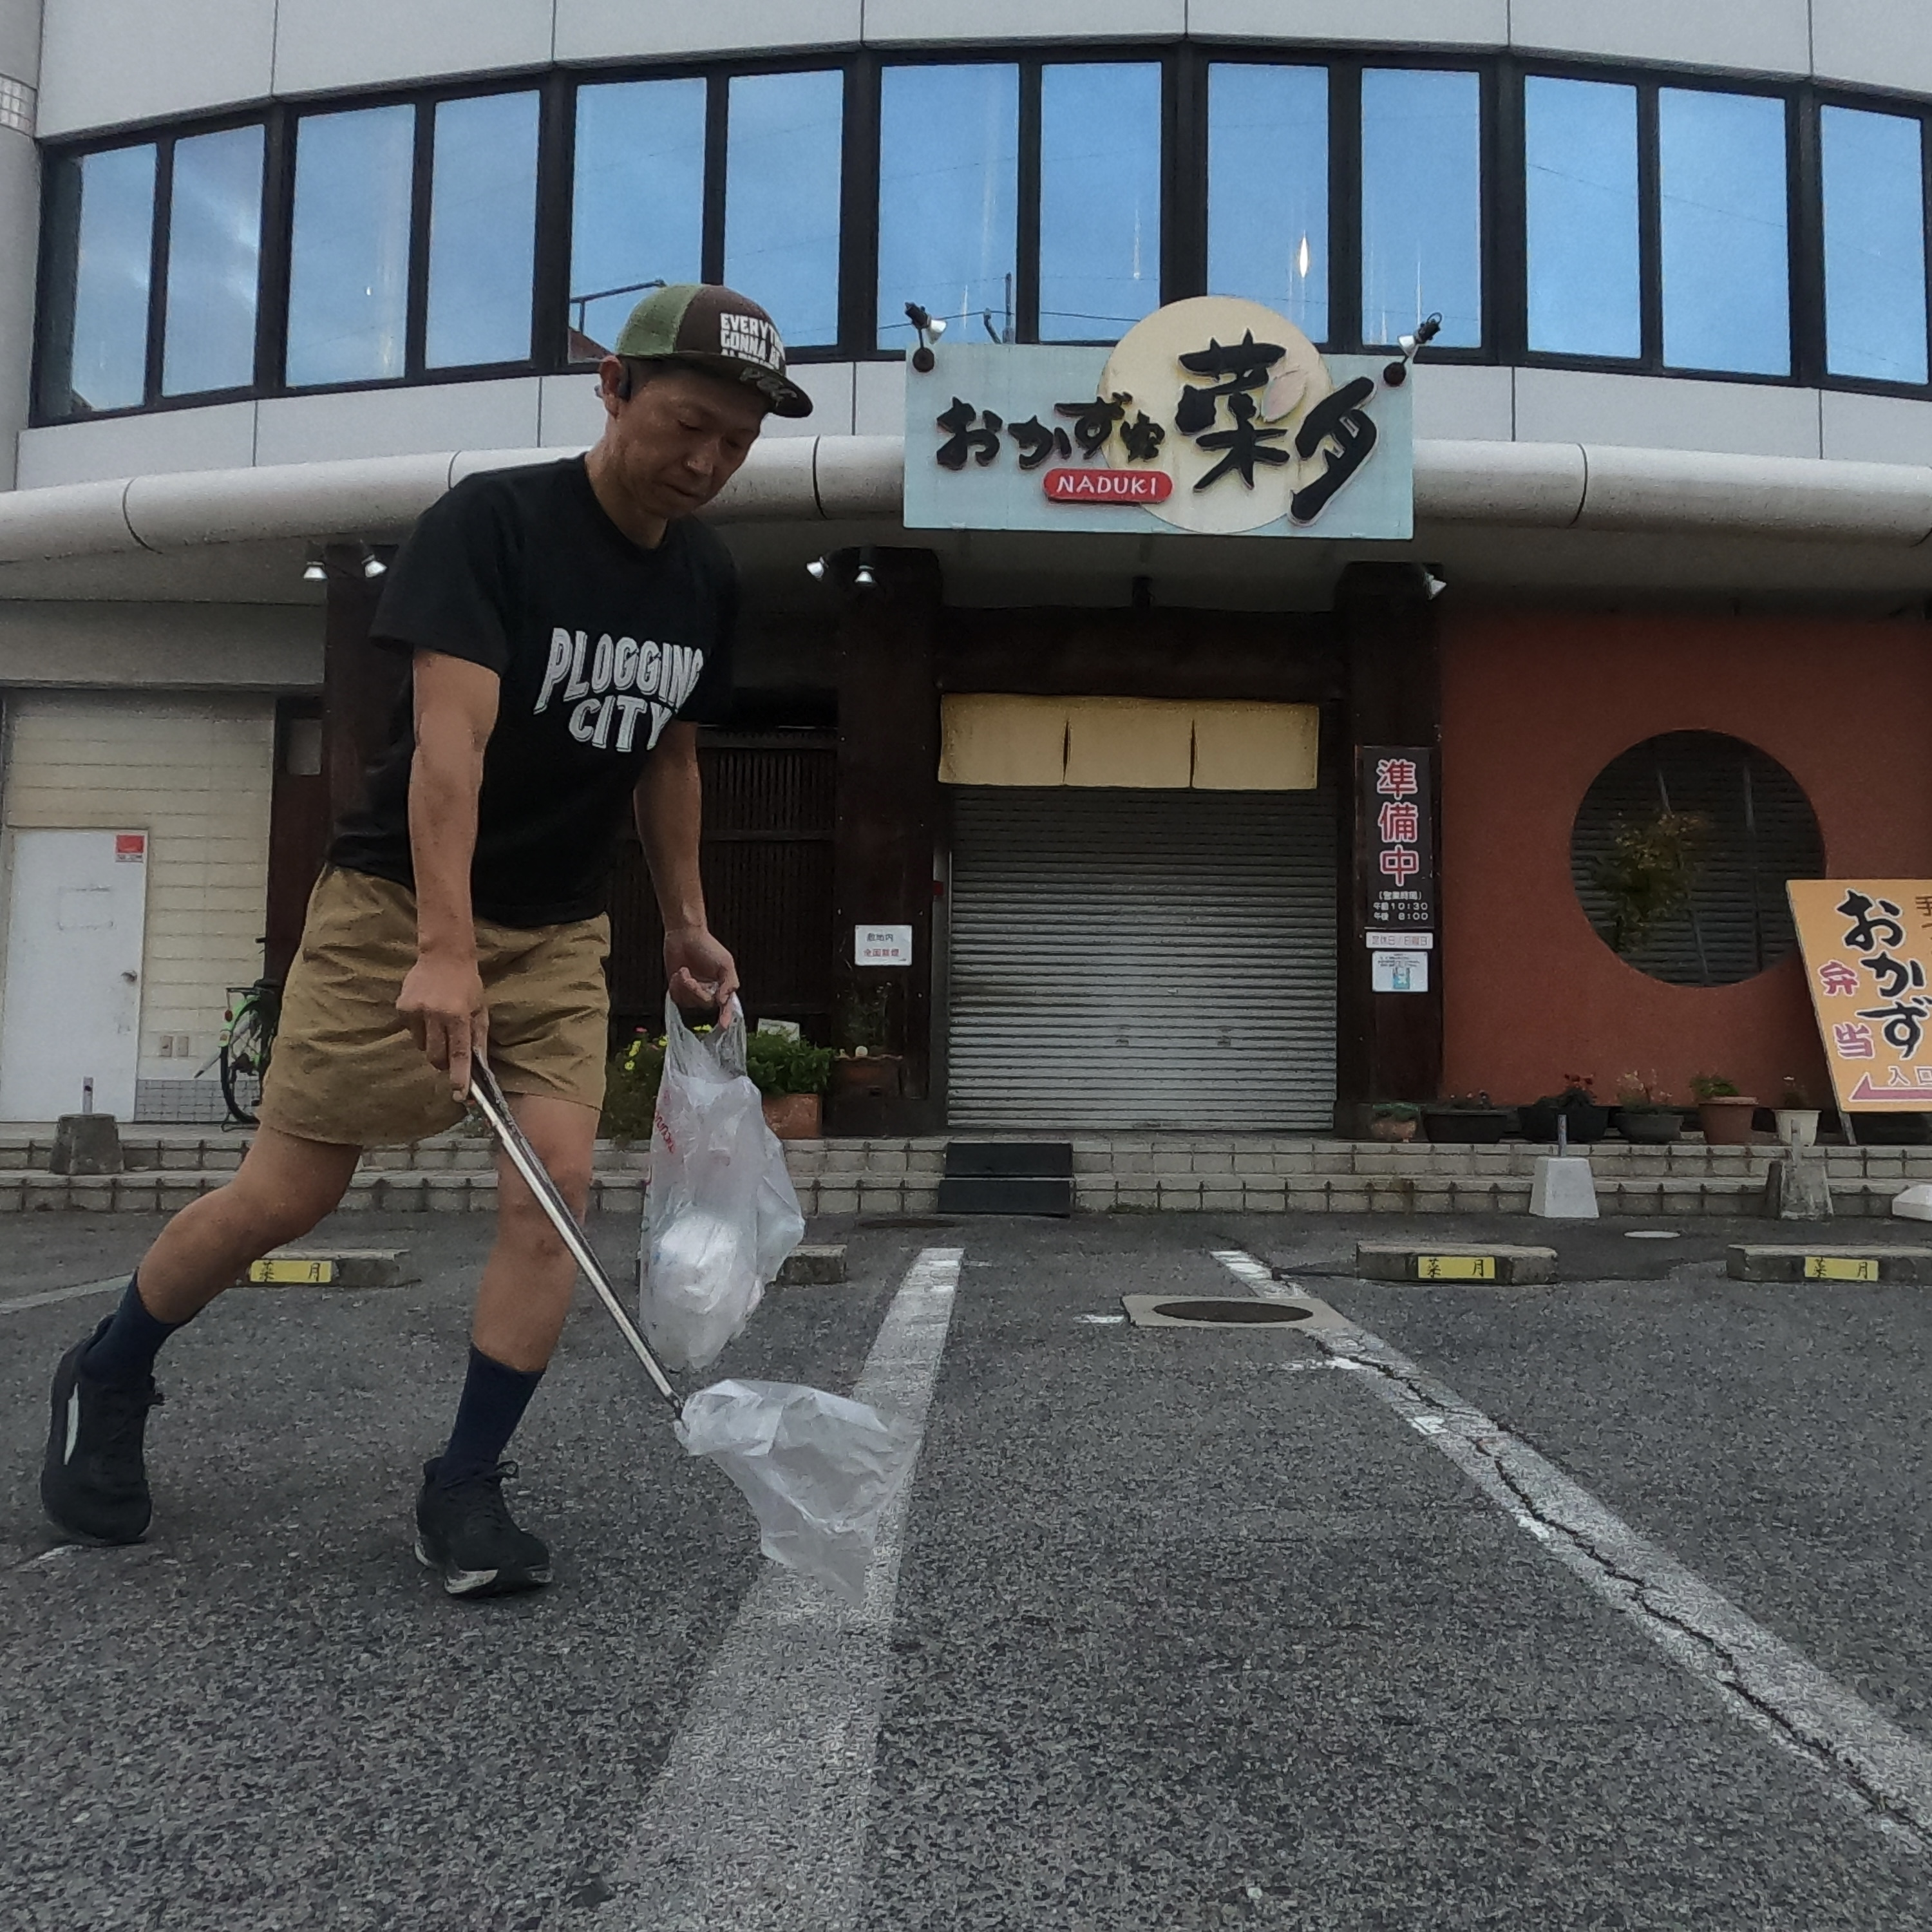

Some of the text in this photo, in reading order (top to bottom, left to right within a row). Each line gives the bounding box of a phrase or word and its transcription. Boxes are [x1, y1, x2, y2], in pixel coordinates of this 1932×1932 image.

[720, 330, 766, 360] GONNA
[1056, 475, 1157, 495] NADUKI
[533, 627, 703, 715] PLOGGING
[569, 696, 672, 752] CITY
[1377, 759, 1419, 887] 準備中
[1818, 960, 1875, 1059] 弁当
[1835, 888, 1932, 1059] おかず
[1888, 1066, 1932, 1086] 入口
